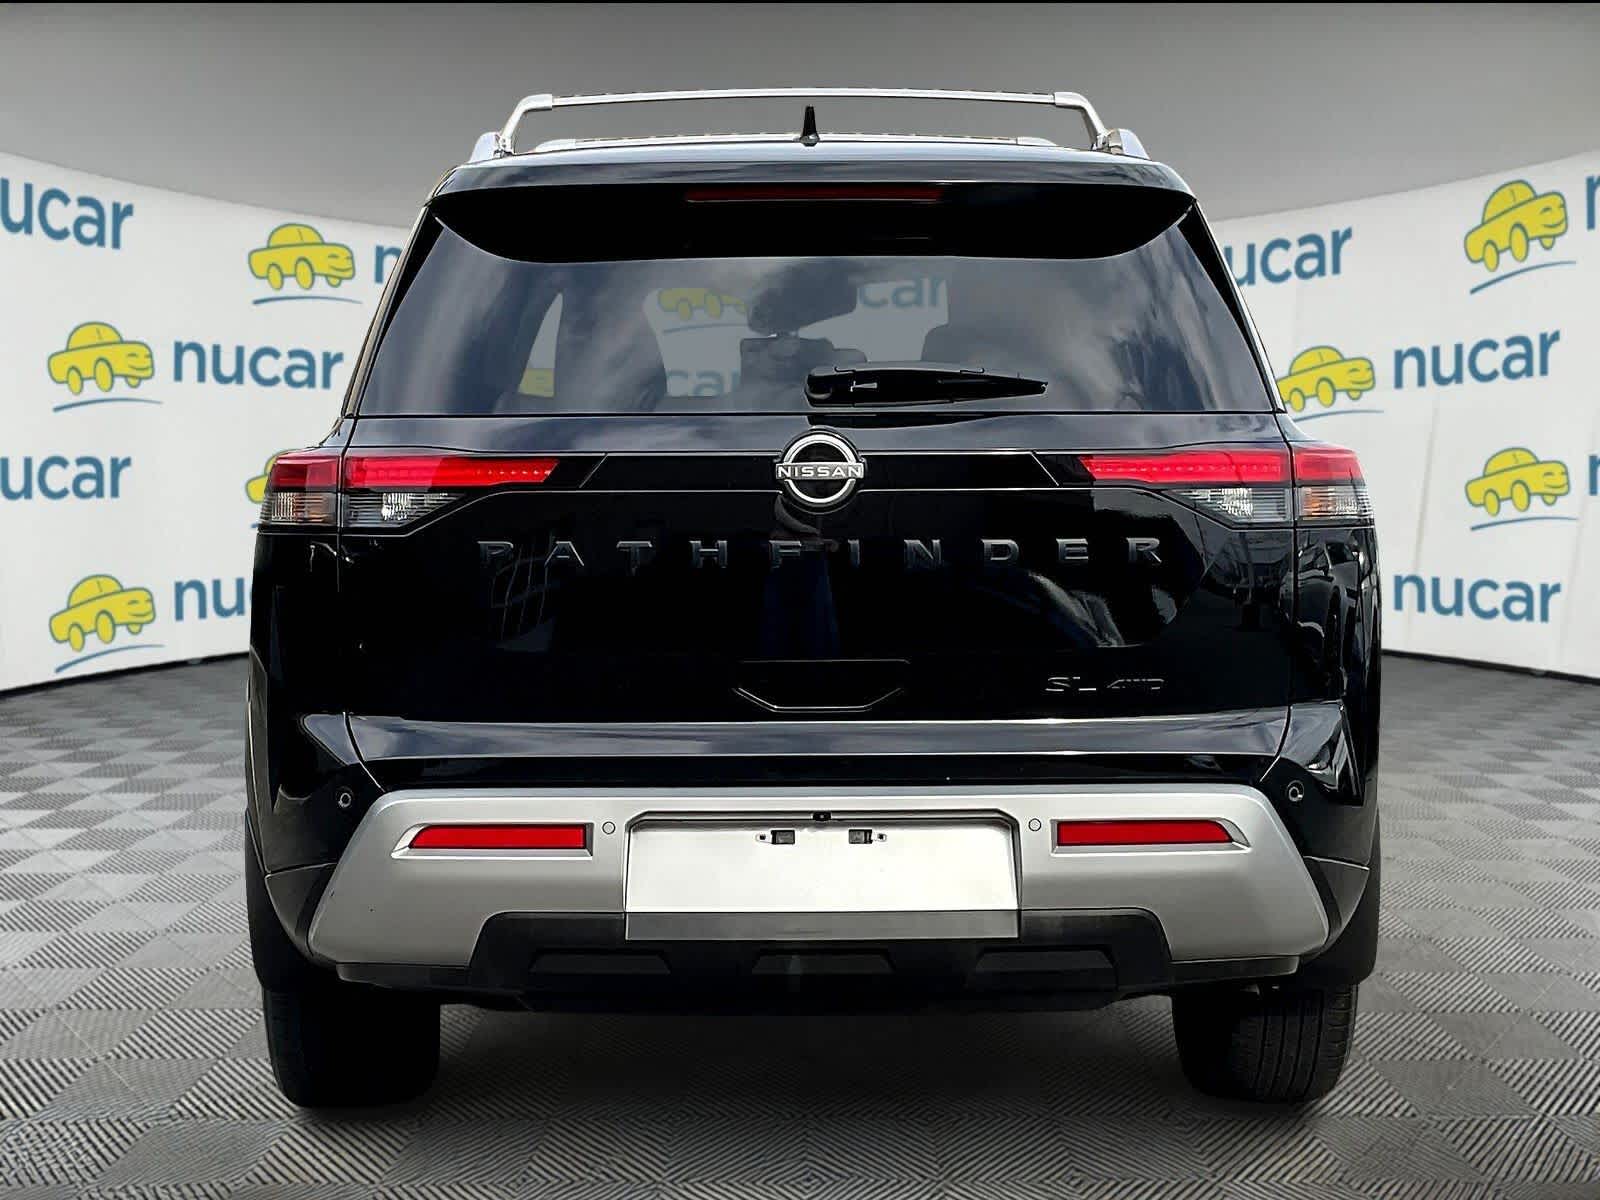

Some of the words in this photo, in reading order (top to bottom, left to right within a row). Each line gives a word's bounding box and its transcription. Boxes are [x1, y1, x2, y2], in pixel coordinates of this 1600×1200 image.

[173, 341, 344, 389] nucar
[1394, 330, 1561, 389] nucar
[777, 465, 861, 478] NISSAN
[477, 537, 1163, 571] PATHFINDER
[1393, 574, 1562, 622] nucar
